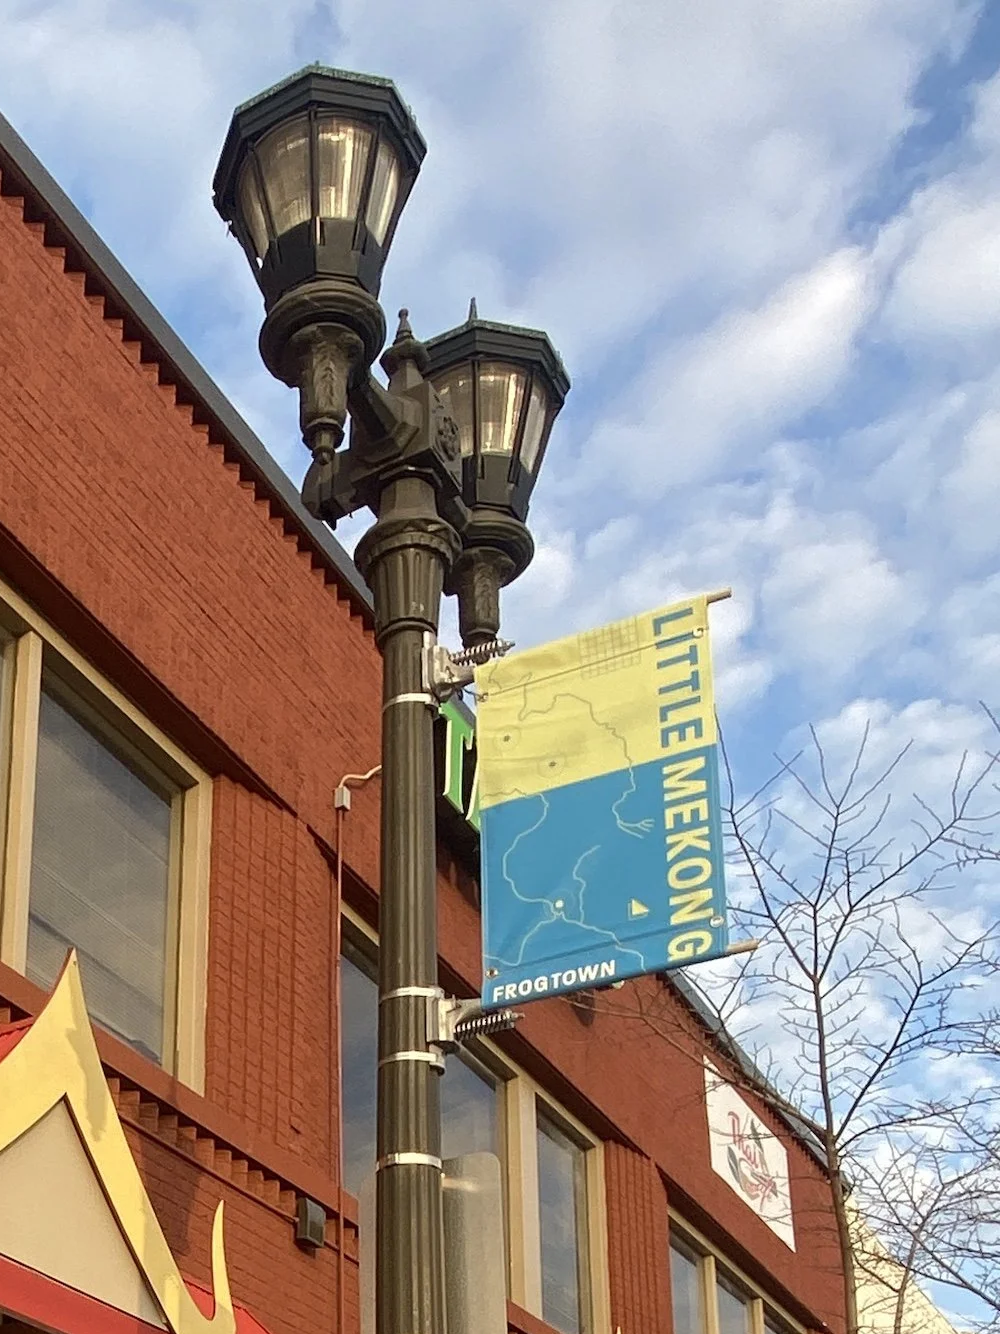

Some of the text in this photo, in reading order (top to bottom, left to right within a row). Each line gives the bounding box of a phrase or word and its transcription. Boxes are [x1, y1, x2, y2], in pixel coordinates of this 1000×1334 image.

[652, 606, 713, 963] LITTLE MEKONG
[492, 959, 616, 1003] FROGTOWN
